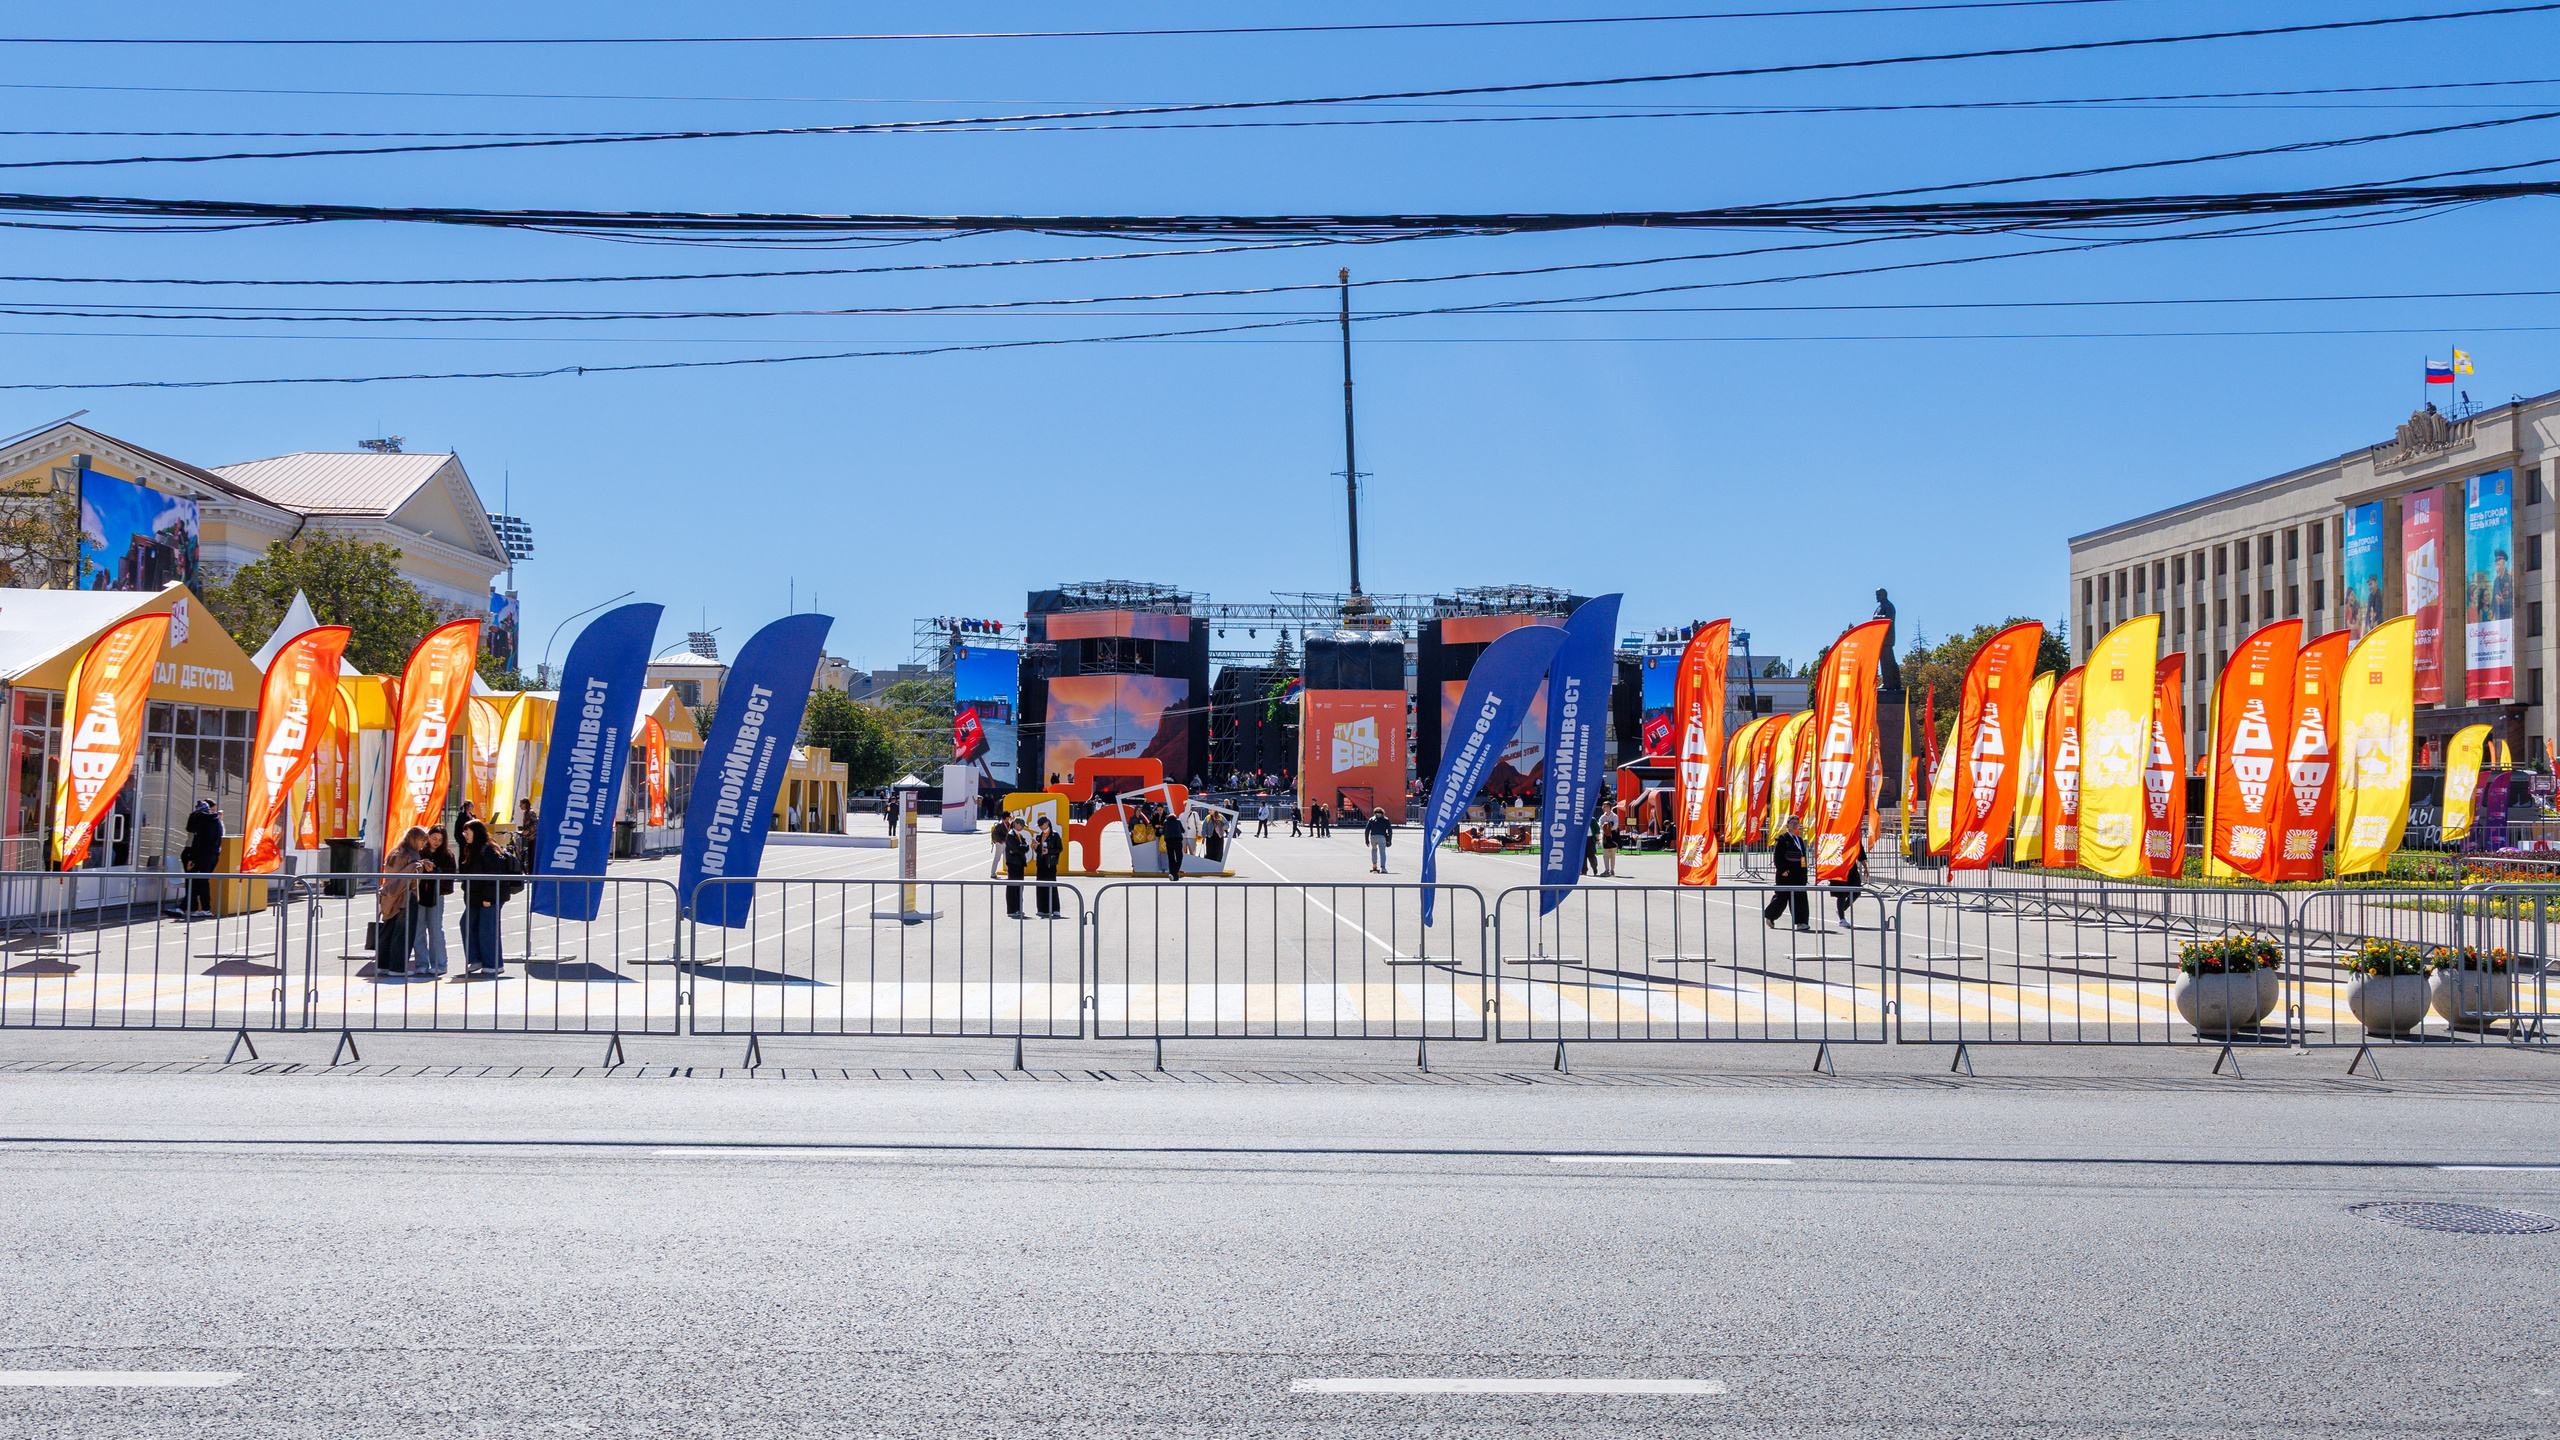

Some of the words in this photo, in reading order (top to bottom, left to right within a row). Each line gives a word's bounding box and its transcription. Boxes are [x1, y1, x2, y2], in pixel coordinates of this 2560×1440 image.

[2359, 536, 2378, 546] ГОРОДА
[2470, 512, 2484, 522] ДЕНЬ
[2484, 507, 2508, 519] ГОРОДА
[2470, 521, 2484, 530] ДЕНЬ
[2485, 518, 2500, 528] КРАЯ
[2358, 545, 2370, 554] КРАЯ
[2407, 538, 2439, 582] СТУД
[2418, 628, 2439, 637] ГОРОДА
[151, 662, 176, 684] ТАЛ
[180, 664, 234, 692] ДЕТСТВА
[73, 692, 120, 750] СТУД
[267, 698, 308, 757] СТУД
[408, 698, 447, 755] СТУД
[1091, 736, 1112, 750] Участие
[1117, 742, 1136, 753] этапе
[1334, 716, 1379, 749] СТУД
[1681, 702, 1708, 759] СТУД
[1821, 702, 1854, 760] СТУД
[1971, 702, 2004, 759] СТУД
[2054, 726, 2079, 770] СТУД
[2145, 720, 2173, 767] СТУД
[2232, 698, 2273, 755] СТУД
[2289, 708, 2329, 762] СТУД
[550, 676, 609, 870] ЮгСтройИнвест
[592, 788, 608, 826] ГРУППА
[600, 727, 618, 783] КОМПАНИЙ
[1332, 738, 1379, 774] ВЕСНА
[1523, 745, 1539, 756] этапе
[1547, 676, 1580, 871] ЮгСтройИнвест
[1577, 724, 1590, 782] КОМПАНИЙ
[71, 752, 120, 812] ВЕСНА
[405, 755, 441, 814] ВЕСНА
[701, 684, 773, 876] ЮгСтройИнвест
[740, 796, 758, 834] ГРУППА
[751, 736, 777, 792] КОМПАНИЙ
[1574, 787, 1586, 826] ГРУППА
[1681, 761, 1709, 821] ВЕСНА
[1820, 761, 1854, 820] ВЕСНА
[1970, 760, 2005, 818] ВЕСНА
[2145, 769, 2175, 819] ВЕСНА
[2231, 756, 2273, 813] ВЕСНА
[2287, 762, 2330, 816] ВЕСНА
